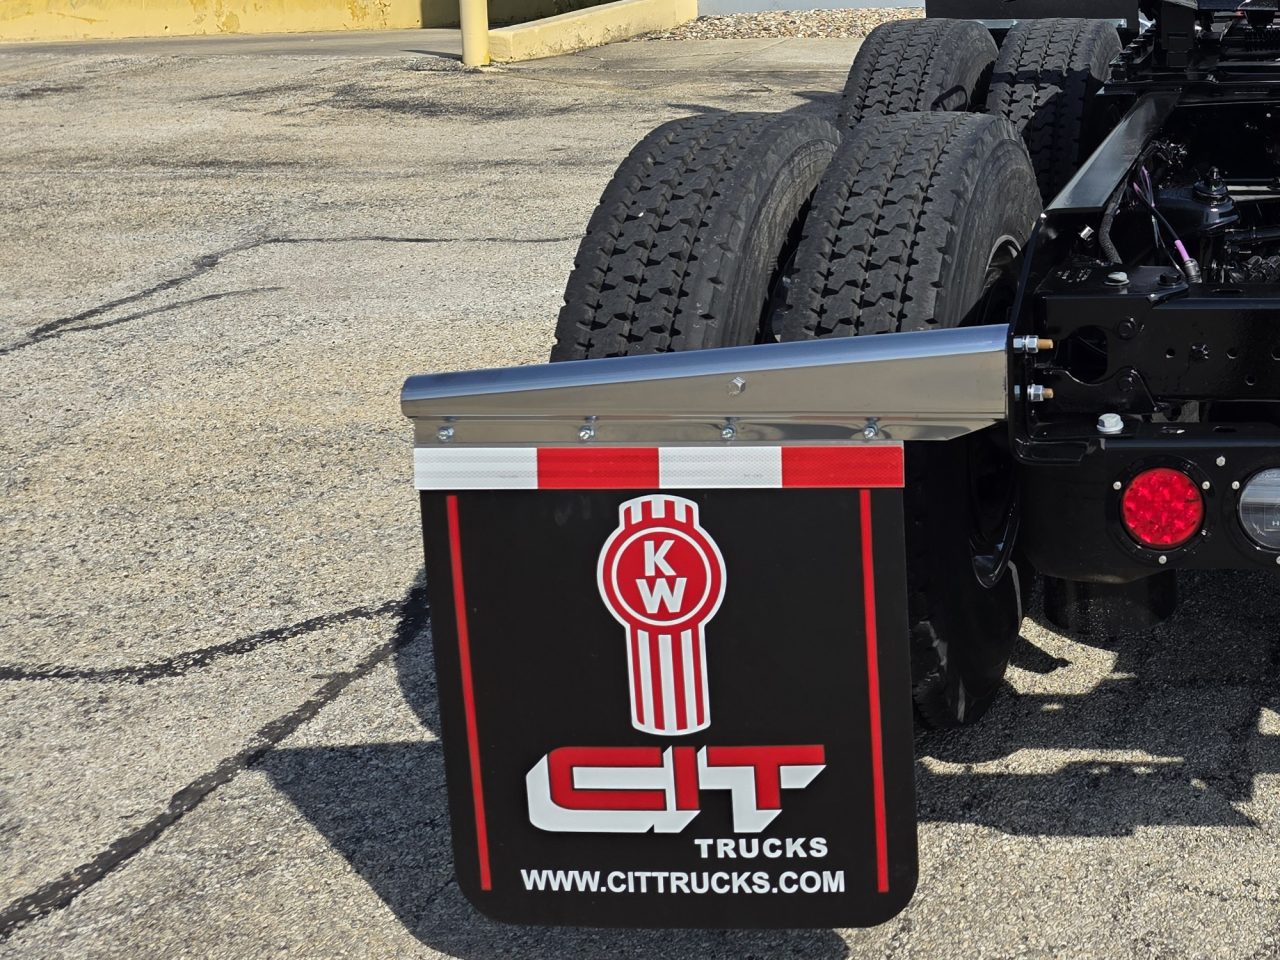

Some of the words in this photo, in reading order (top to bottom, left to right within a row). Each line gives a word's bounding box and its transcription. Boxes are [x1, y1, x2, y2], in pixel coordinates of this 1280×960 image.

[545, 744, 826, 813] CIT
[694, 837, 829, 859] TRUCKS
[521, 869, 846, 894] WWW.CITTRUCKS.COM
